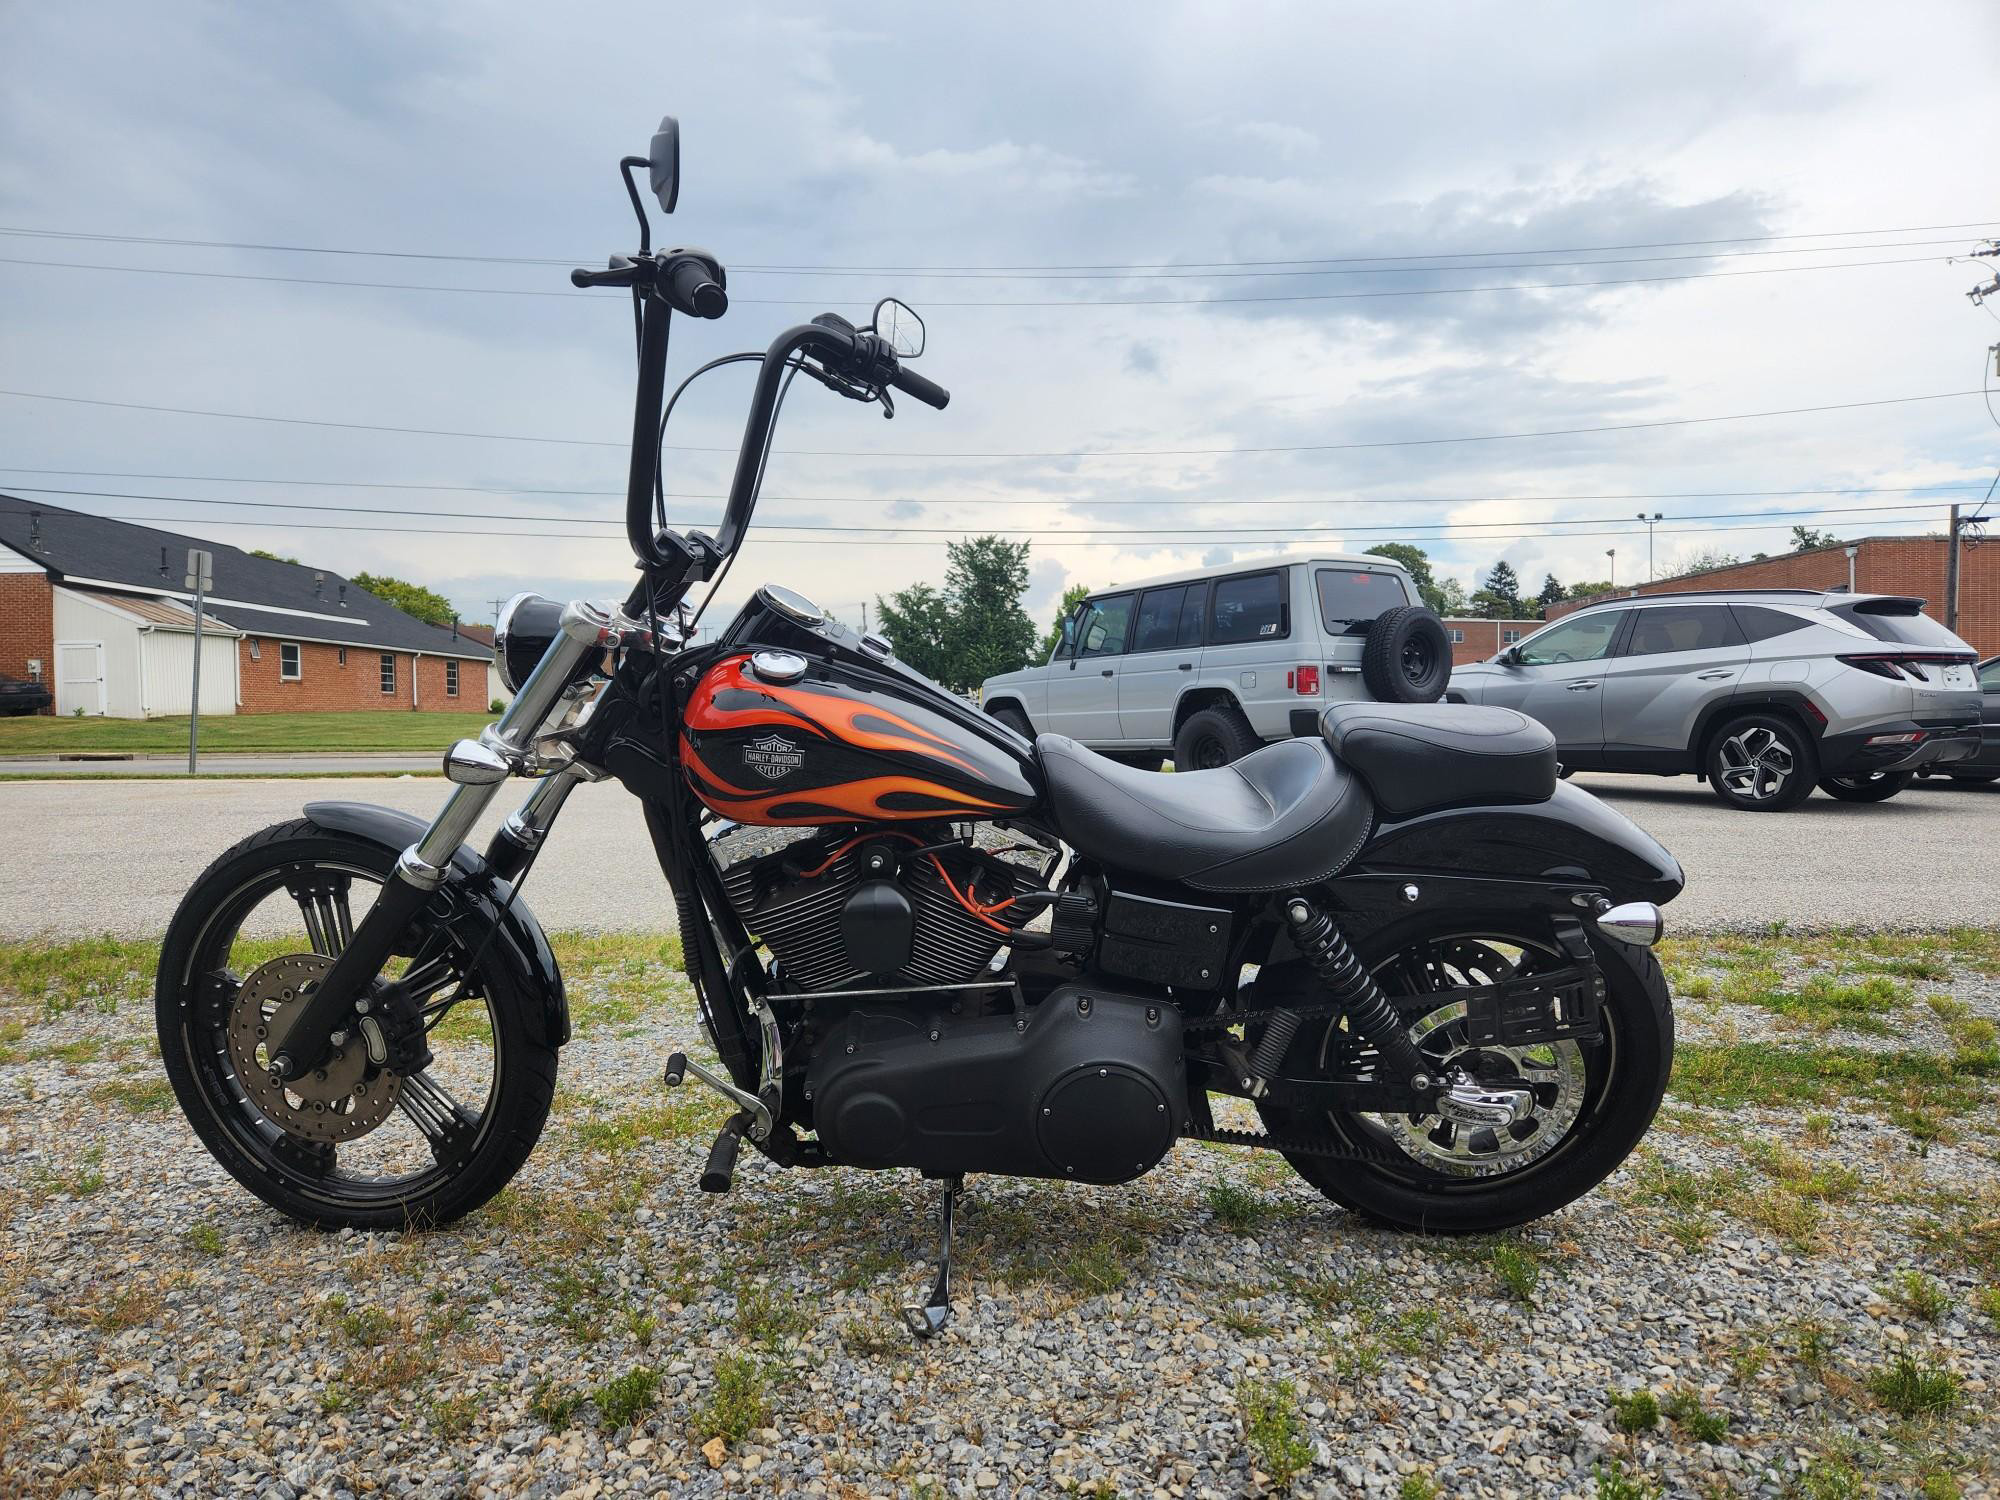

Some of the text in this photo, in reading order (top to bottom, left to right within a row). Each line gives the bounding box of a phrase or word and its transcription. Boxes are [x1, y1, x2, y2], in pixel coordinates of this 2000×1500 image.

[760, 742, 788, 752] MOTOR
[747, 752, 799, 765] HARLEY-DAVIDSON
[758, 765, 786, 776] CYCLES
